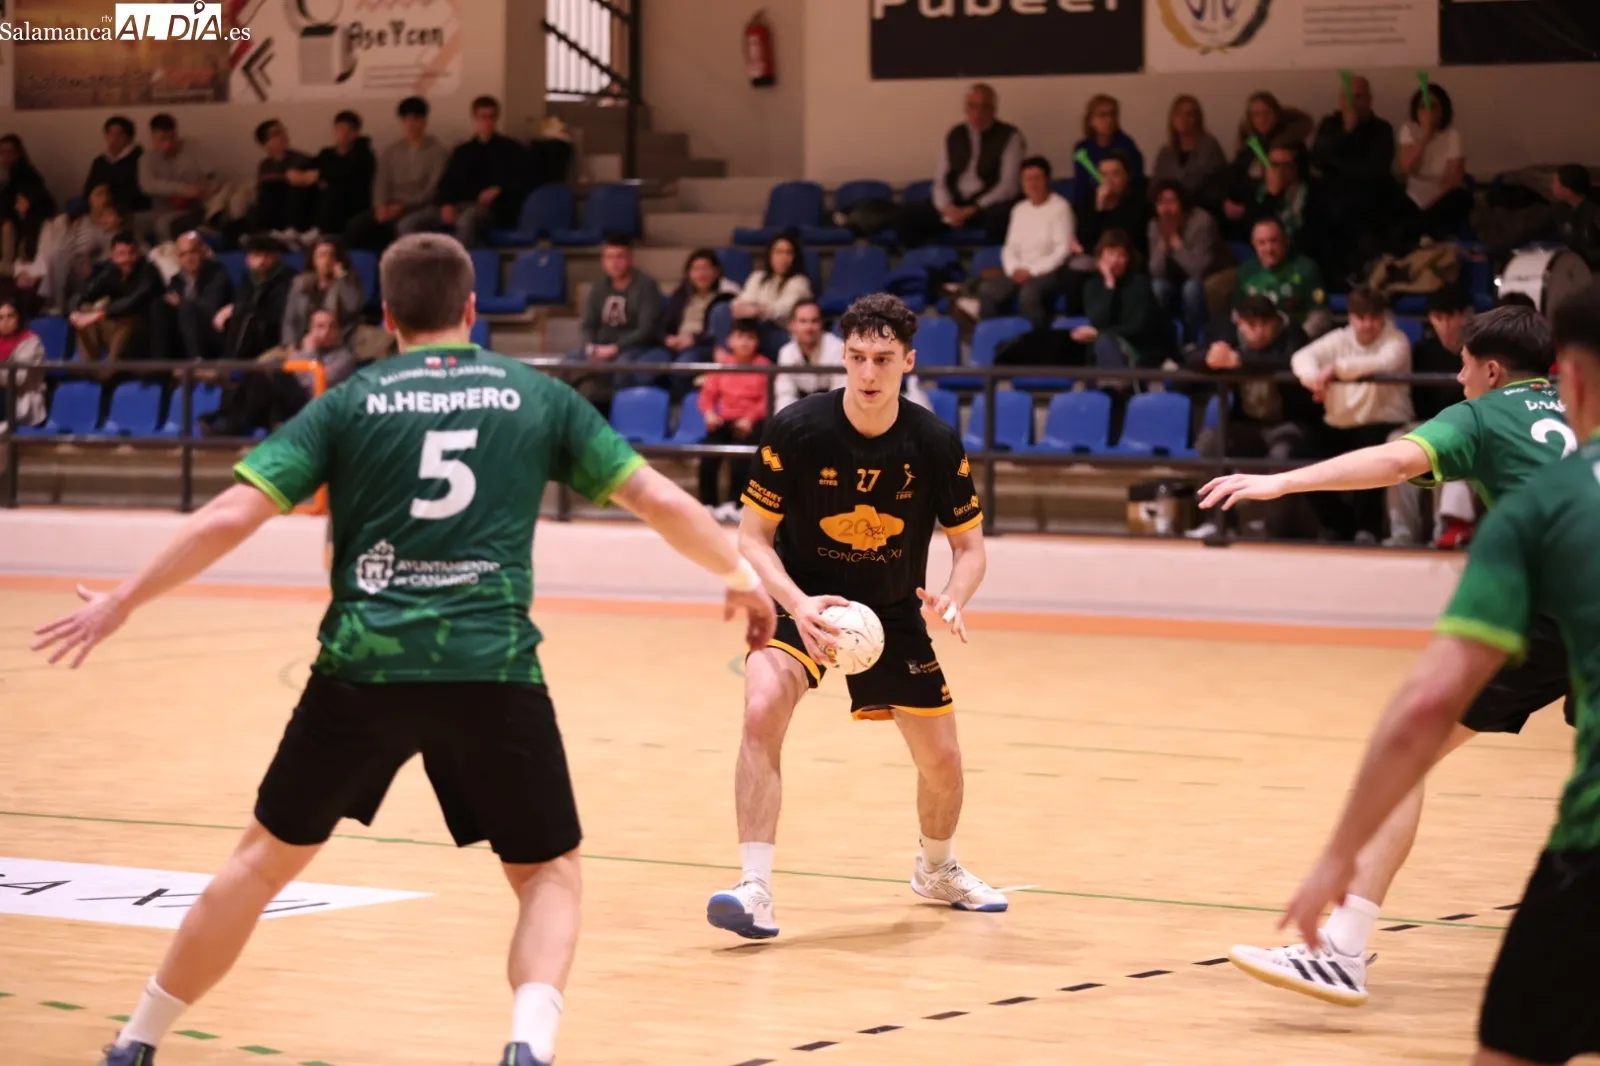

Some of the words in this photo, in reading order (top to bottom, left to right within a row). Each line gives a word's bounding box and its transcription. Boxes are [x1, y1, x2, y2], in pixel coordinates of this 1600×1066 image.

[366, 386, 521, 415] N.HERRERO
[409, 428, 478, 520] 5
[856, 468, 881, 493] 27
